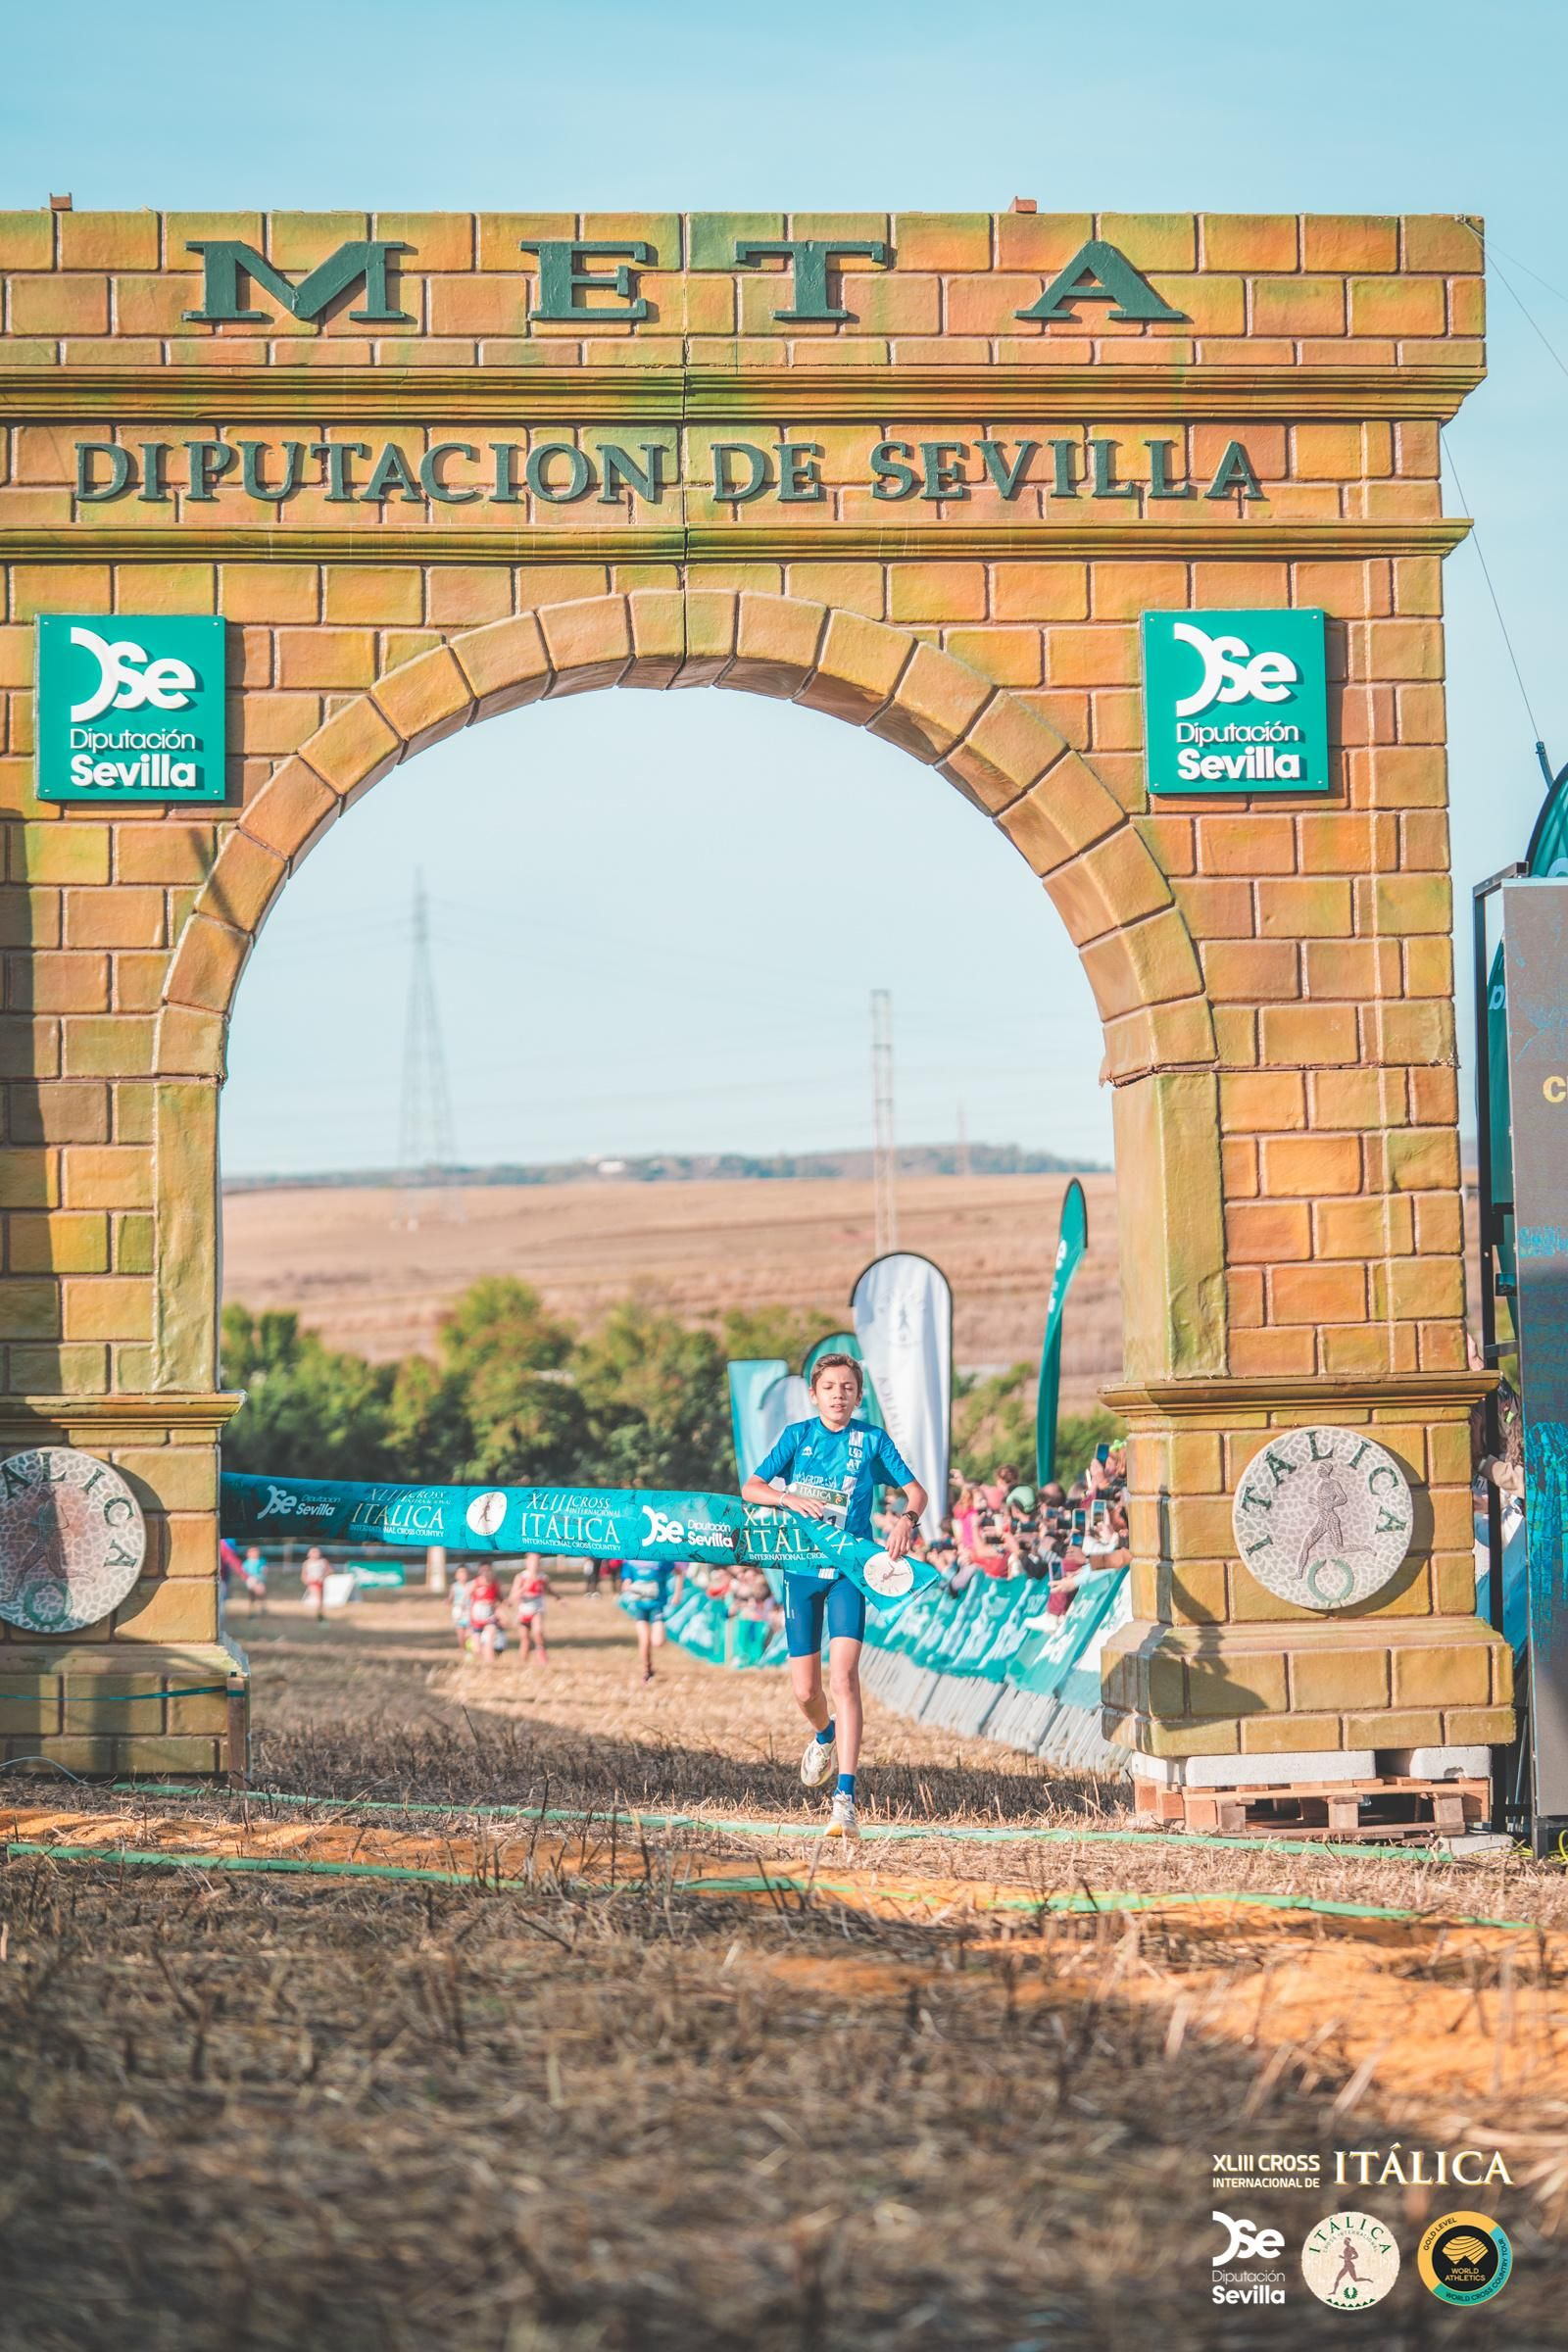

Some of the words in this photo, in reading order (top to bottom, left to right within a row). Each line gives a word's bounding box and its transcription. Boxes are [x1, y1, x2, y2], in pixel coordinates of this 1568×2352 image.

[183, 239, 1185, 322] META
[74, 441, 669, 504] DIPUTACION
[710, 441, 825, 503] DE
[870, 438, 1263, 502] SEVILLA
[71, 728, 196, 753] Diputación
[1176, 720, 1298, 747] Diputación
[71, 754, 196, 787] Sevilla
[1177, 746, 1301, 780] Sevilla
[526, 1493, 574, 1514] XLIII
[571, 1495, 611, 1509] CROSS
[1241, 1430, 1407, 1557] ITALICA
[296, 1502, 335, 1516] Sevilla
[688, 1519, 731, 1532] Diputación
[521, 1537, 571, 1548] INTERNATIONAL
[571, 1541, 592, 1549] CROSS
[591, 1543, 621, 1551] COUNTRY
[688, 1531, 733, 1547] Sevilla
[749, 1552, 805, 1561] INTERNATIONAL
